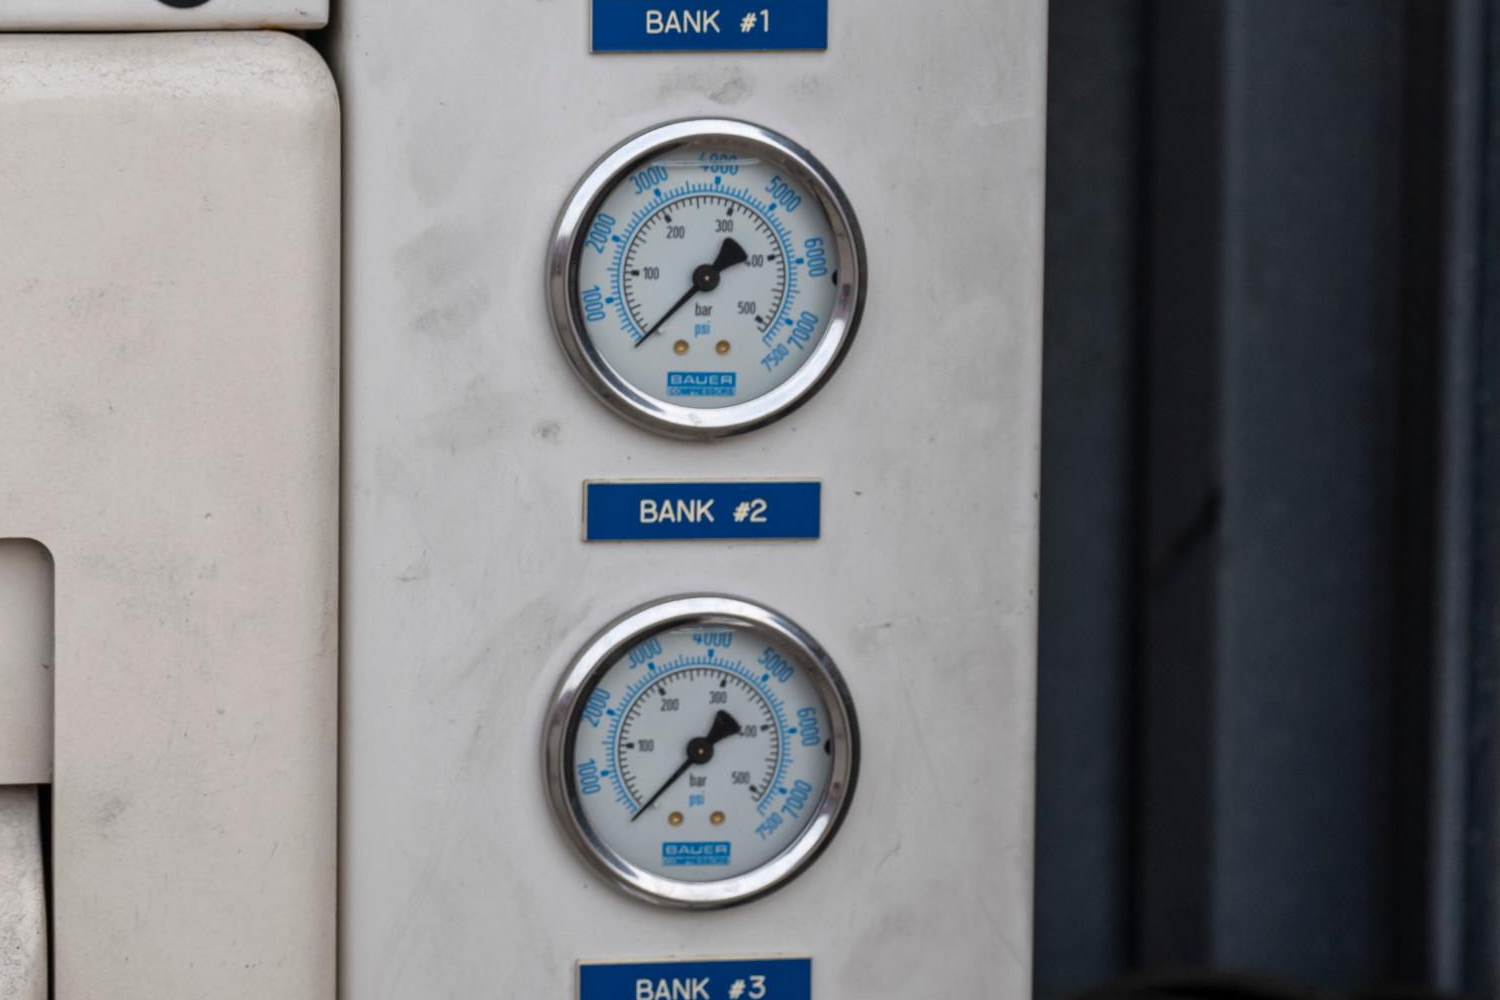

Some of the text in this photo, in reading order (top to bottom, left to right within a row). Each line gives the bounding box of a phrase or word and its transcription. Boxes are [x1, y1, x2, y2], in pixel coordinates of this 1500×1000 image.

[646, 9, 770, 34] BANK #1
[628, 166, 668, 195] 3000
[765, 176, 802, 212] 5000
[584, 213, 616, 254] 2000
[666, 226, 685, 239] 200
[715, 219, 733, 232] 300
[804, 237, 828, 278] 6000
[644, 267, 659, 279] 100
[582, 285, 606, 323] 1000
[695, 303, 712, 317] bar
[738, 302, 756, 314] 500
[788, 311, 819, 350] 7000
[671, 375, 733, 384] BAUER
[640, 498, 767, 523] BANK #2
[758, 647, 794, 684] 5000
[661, 699, 679, 711] 200
[797, 707, 820, 747] 6000
[638, 740, 654, 752] 100
[578, 759, 601, 795] 1000
[635, 975, 766, 1000] BANK #3
